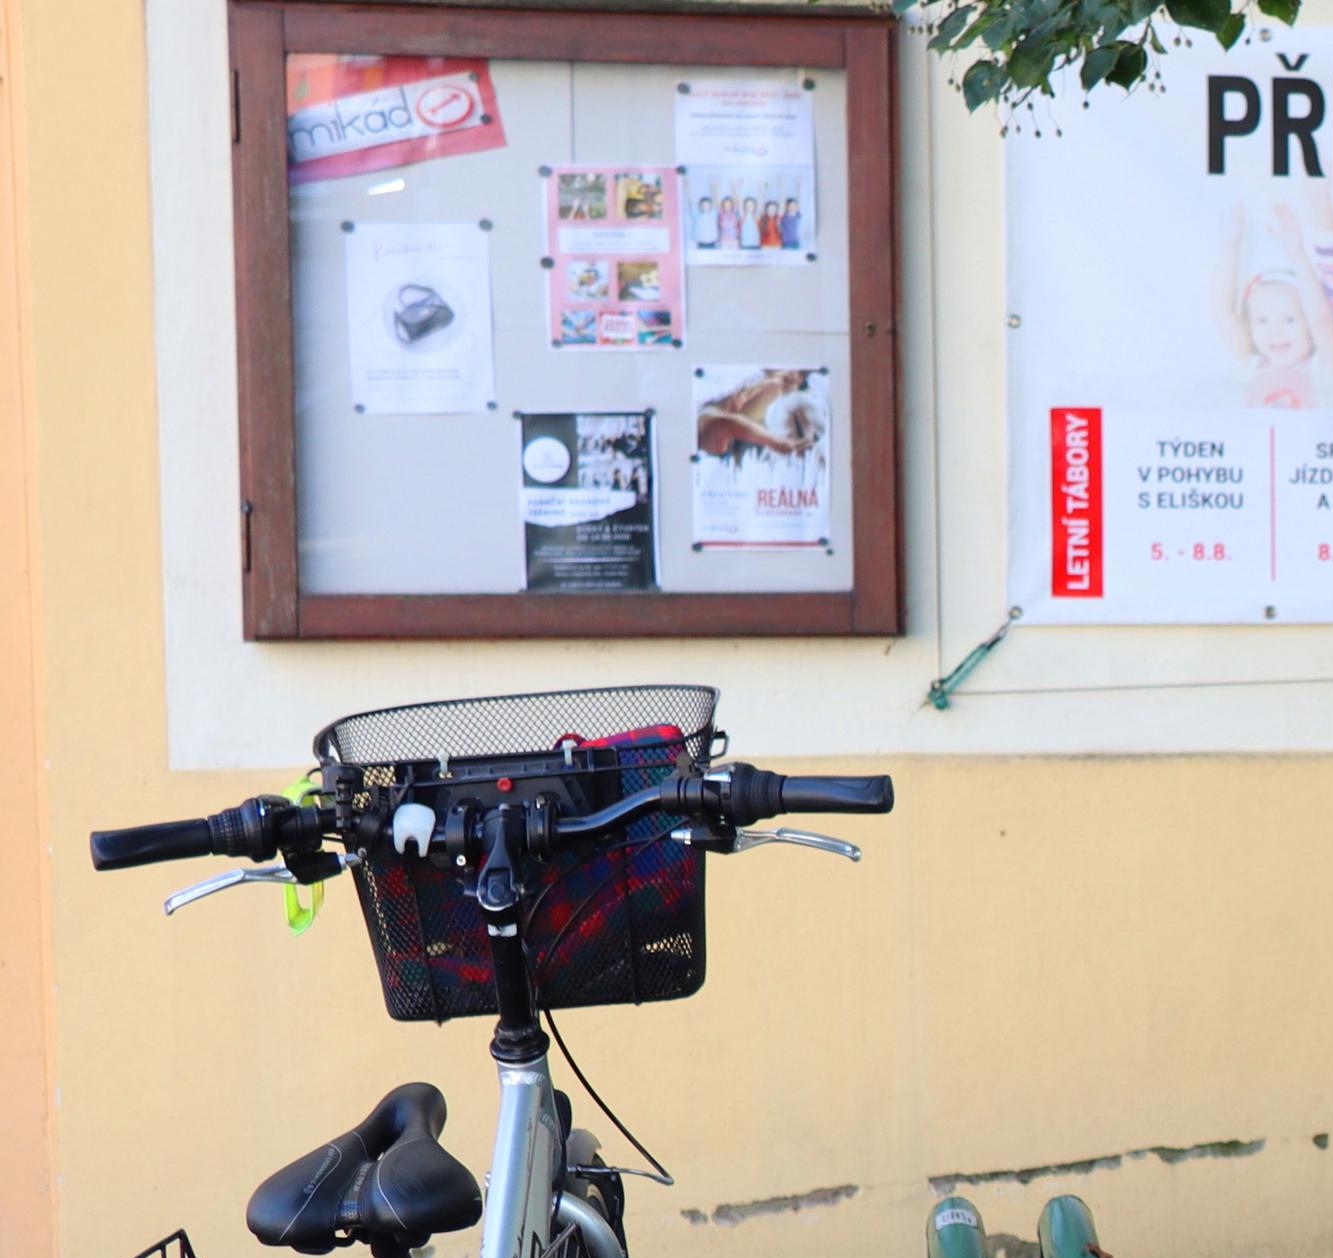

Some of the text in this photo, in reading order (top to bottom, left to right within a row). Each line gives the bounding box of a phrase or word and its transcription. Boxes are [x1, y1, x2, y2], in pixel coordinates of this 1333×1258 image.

[1157, 437, 1225, 458] TÝDEN
[1138, 466, 1244, 484] V POHYBU
[757, 486, 819, 508] REÁLNÁ
[1062, 414, 1090, 590] LETNÍ TÁBORY
[1138, 488, 1244, 509] S ELIŠKOU
[1316, 493, 1330, 510] A
[1151, 542, 1169, 561] 5.
[1192, 542, 1232, 561] 8.8.
